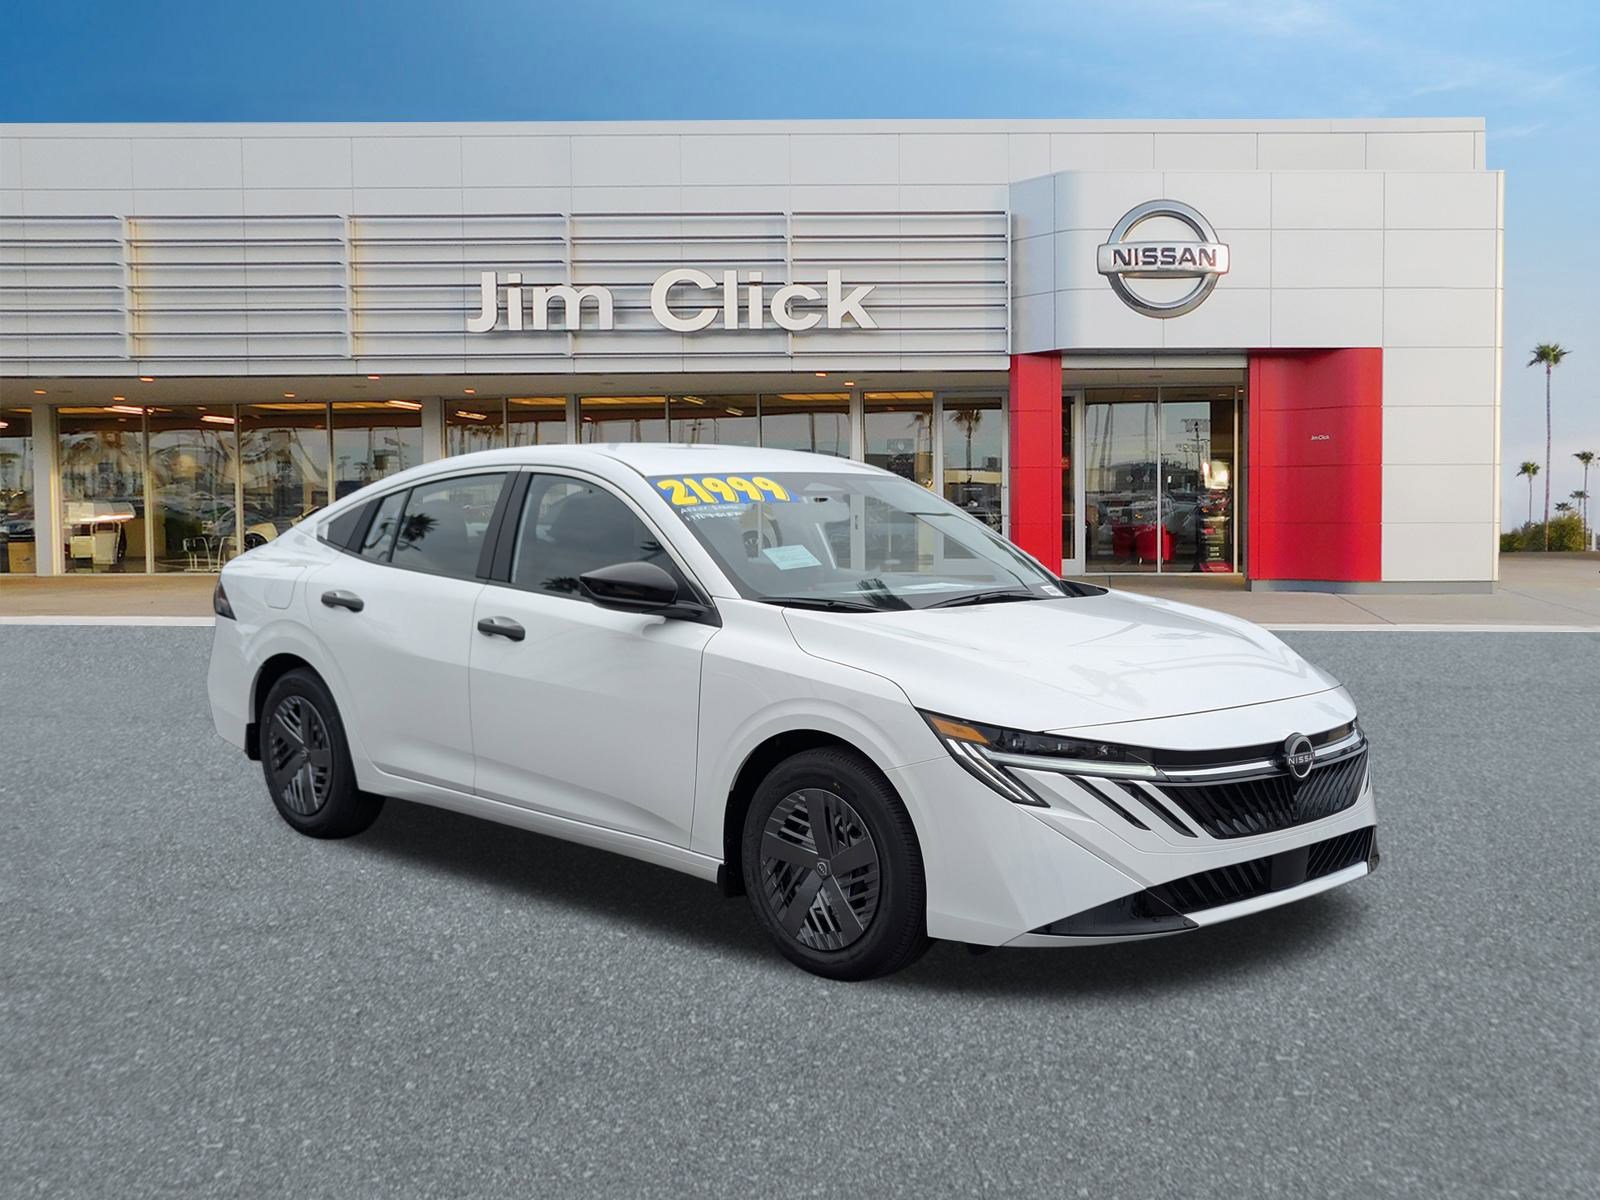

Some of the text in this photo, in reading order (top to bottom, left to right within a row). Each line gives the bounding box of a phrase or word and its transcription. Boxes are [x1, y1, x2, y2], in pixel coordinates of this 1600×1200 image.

[1112, 247, 1217, 266] NISSAN
[467, 268, 878, 333] Jim Click
[657, 476, 790, 505] 21999
